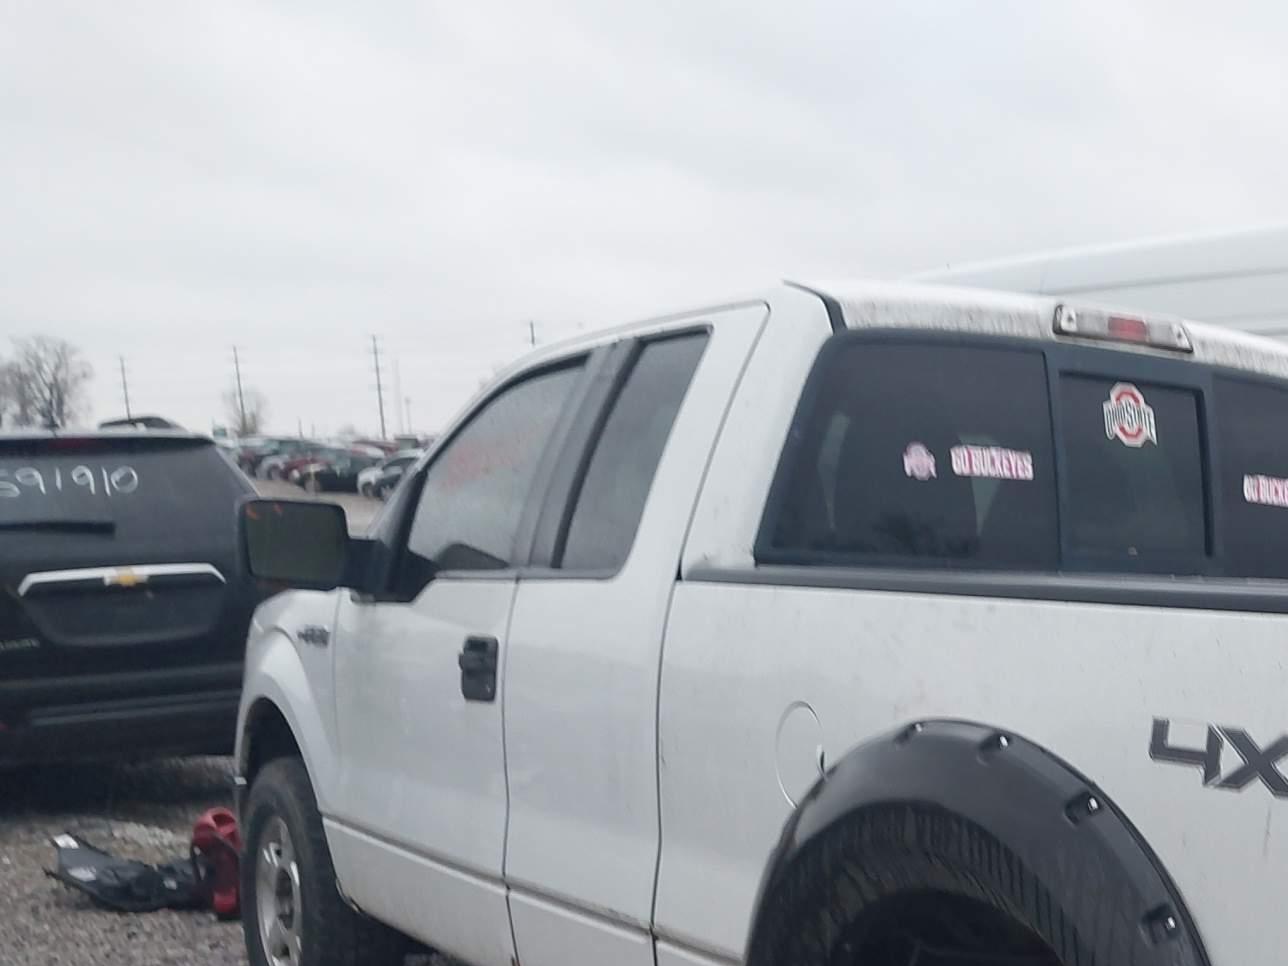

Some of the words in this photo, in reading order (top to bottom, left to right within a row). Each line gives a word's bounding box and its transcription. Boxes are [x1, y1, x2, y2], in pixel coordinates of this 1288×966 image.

[950, 446, 969, 476] GO
[970, 446, 1034, 481] BUCKEYES
[1244, 474, 1259, 503] GO
